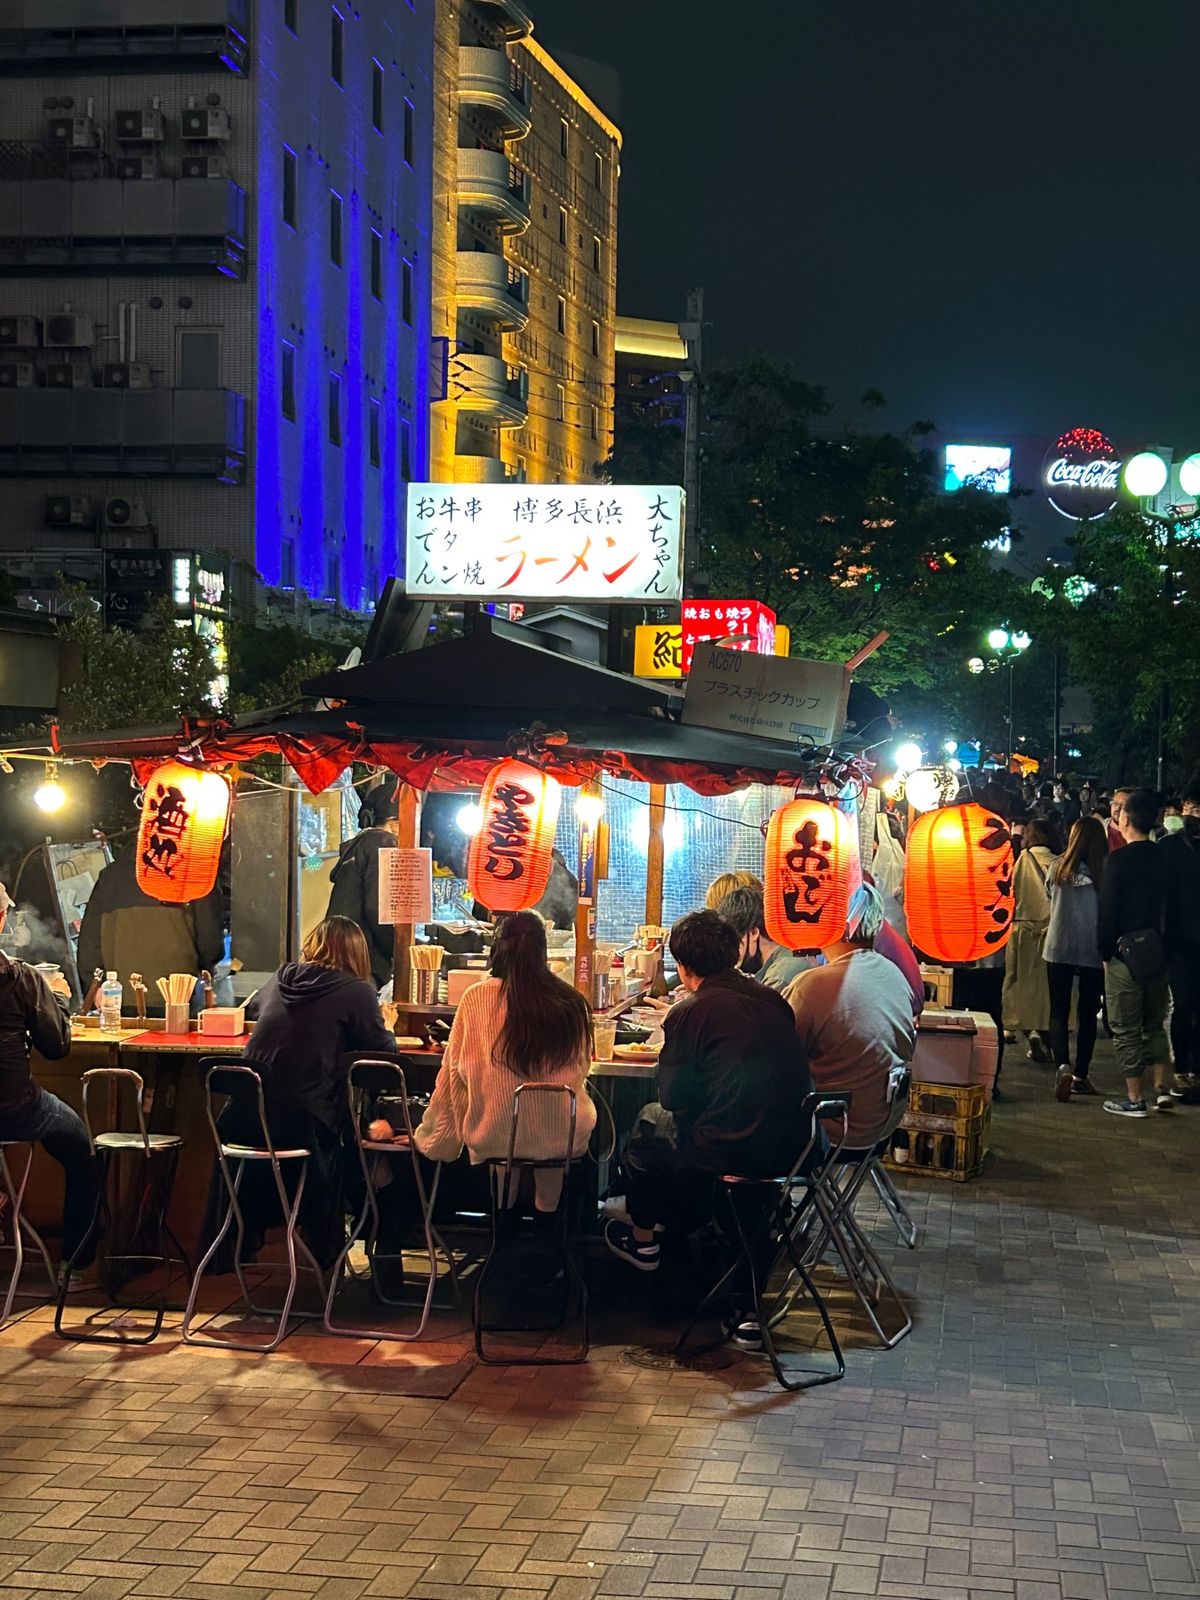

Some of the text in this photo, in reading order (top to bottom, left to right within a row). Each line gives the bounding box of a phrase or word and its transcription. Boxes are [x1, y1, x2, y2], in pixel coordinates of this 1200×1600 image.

[415, 496, 438, 585] おでん
[439, 496, 461, 585] 牛タン
[464, 496, 485, 585] 串焼
[513, 498, 623, 524] 博多長浜
[644, 494, 673, 594] 大ちゃん
[495, 535, 640, 590] ラーメン
[707, 651, 742, 672] AC670
[485, 783, 535, 881] やきとり
